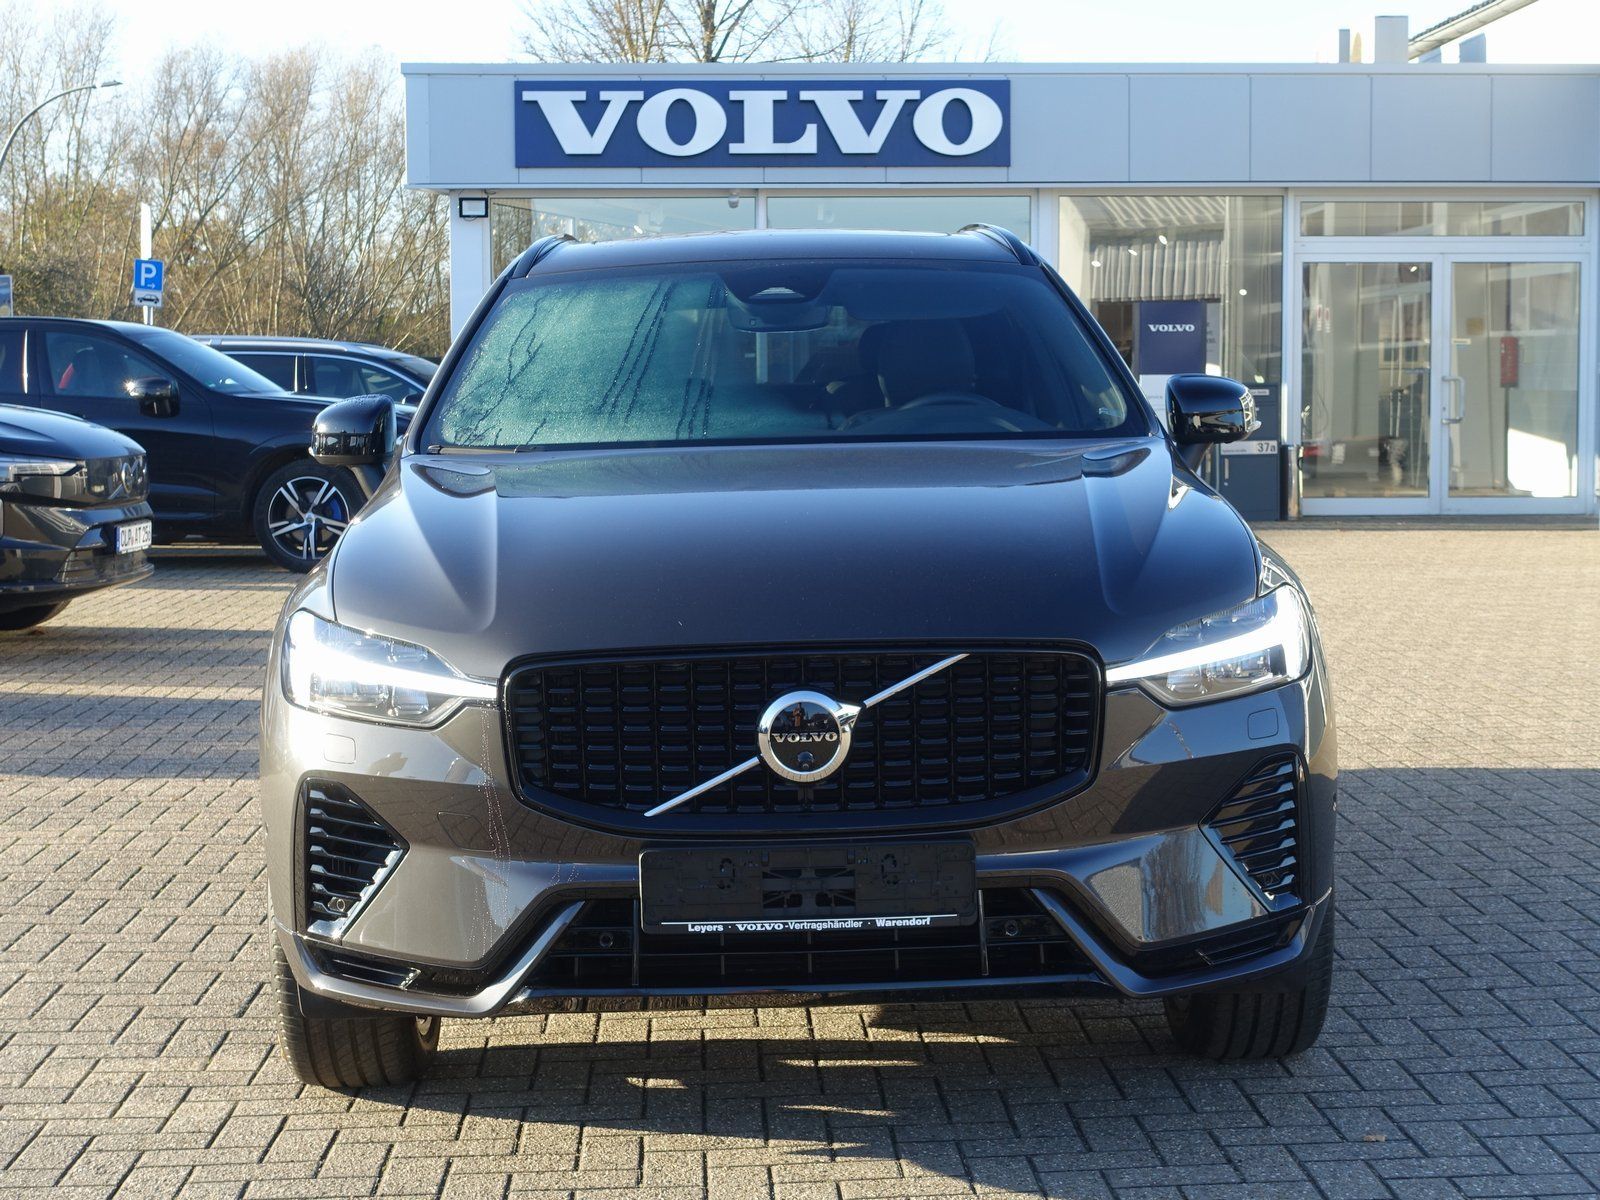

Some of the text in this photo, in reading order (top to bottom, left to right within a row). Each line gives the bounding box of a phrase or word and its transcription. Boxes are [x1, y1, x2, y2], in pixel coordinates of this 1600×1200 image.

[522, 88, 1003, 156] VOLVO
[141, 262, 157, 287] P
[1148, 323, 1195, 332] VOLVO
[1257, 442, 1276, 452] 37a
[771, 731, 838, 743] VOLVO
[687, 923, 724, 934] Leyers
[875, 916, 931, 928] Warendorf
